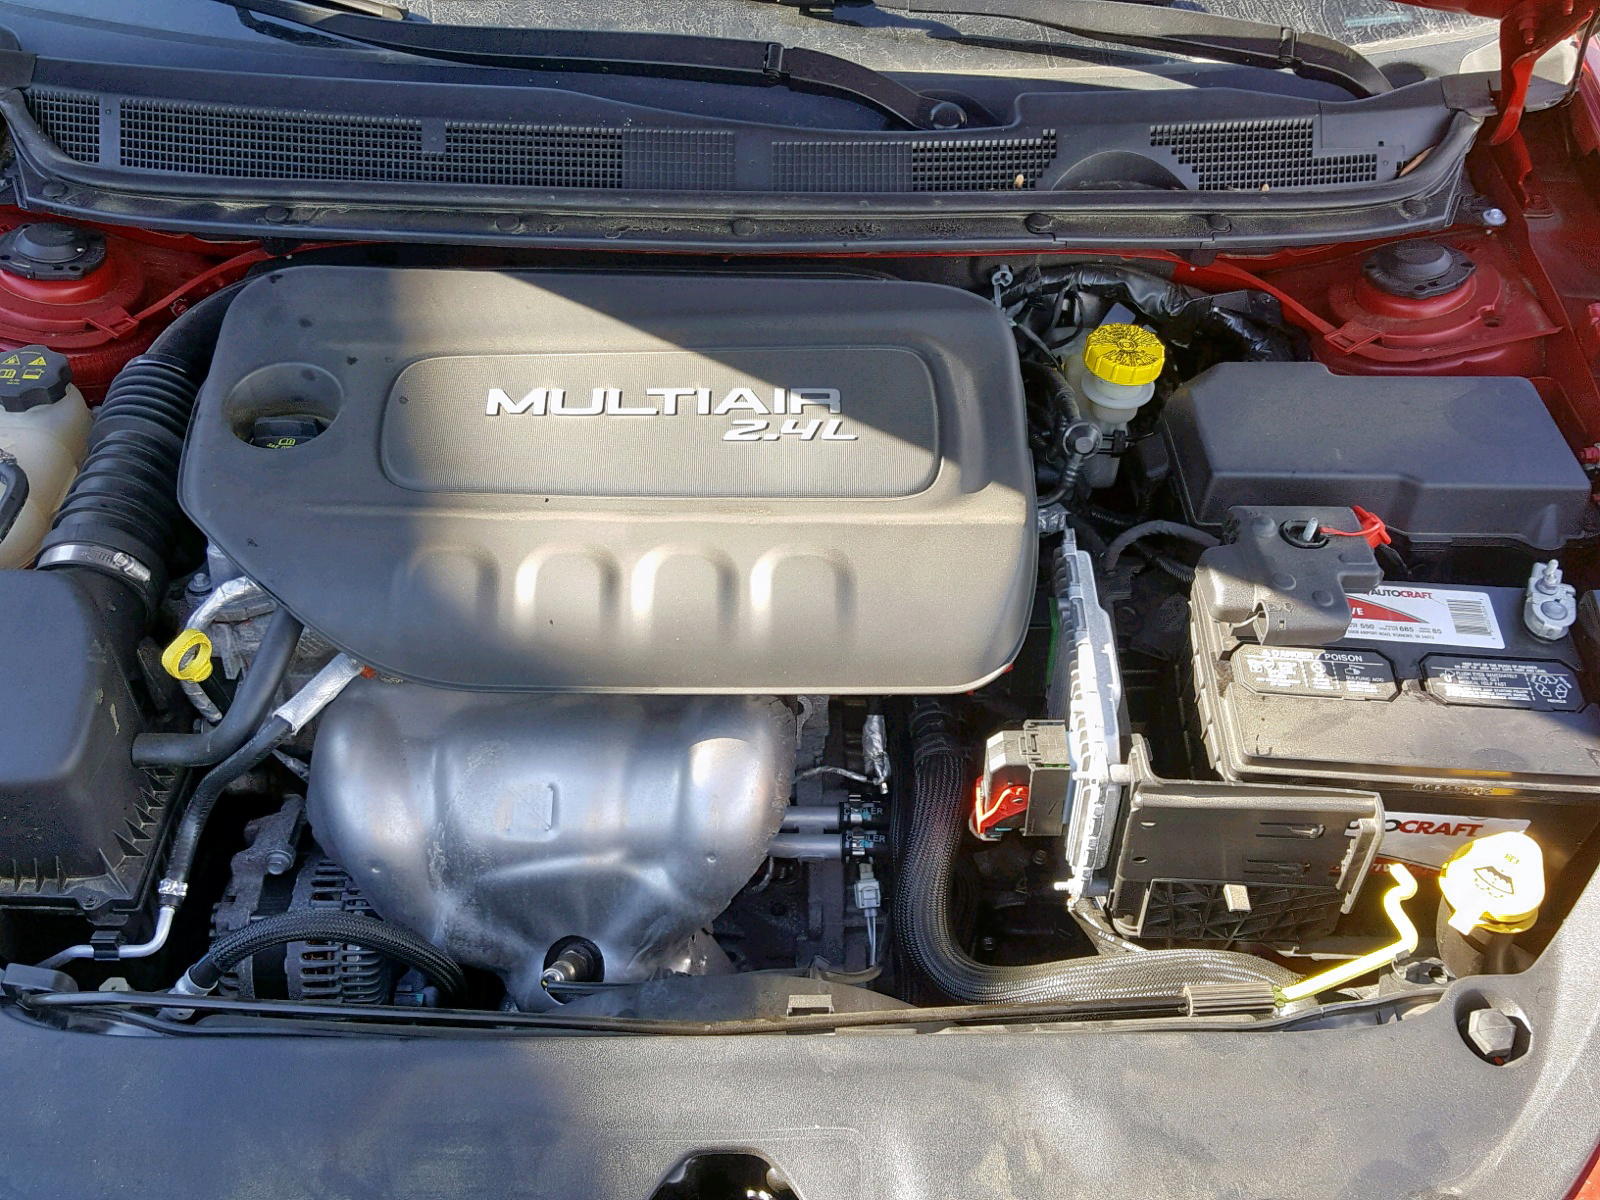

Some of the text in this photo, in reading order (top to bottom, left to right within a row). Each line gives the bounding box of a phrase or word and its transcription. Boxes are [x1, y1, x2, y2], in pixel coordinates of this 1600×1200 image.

[485, 387, 842, 416] MULTIAIR
[722, 418, 859, 442] 2.4L
[1371, 589, 1433, 600] AUTOCRAFT
[1324, 653, 1363, 662] POISON
